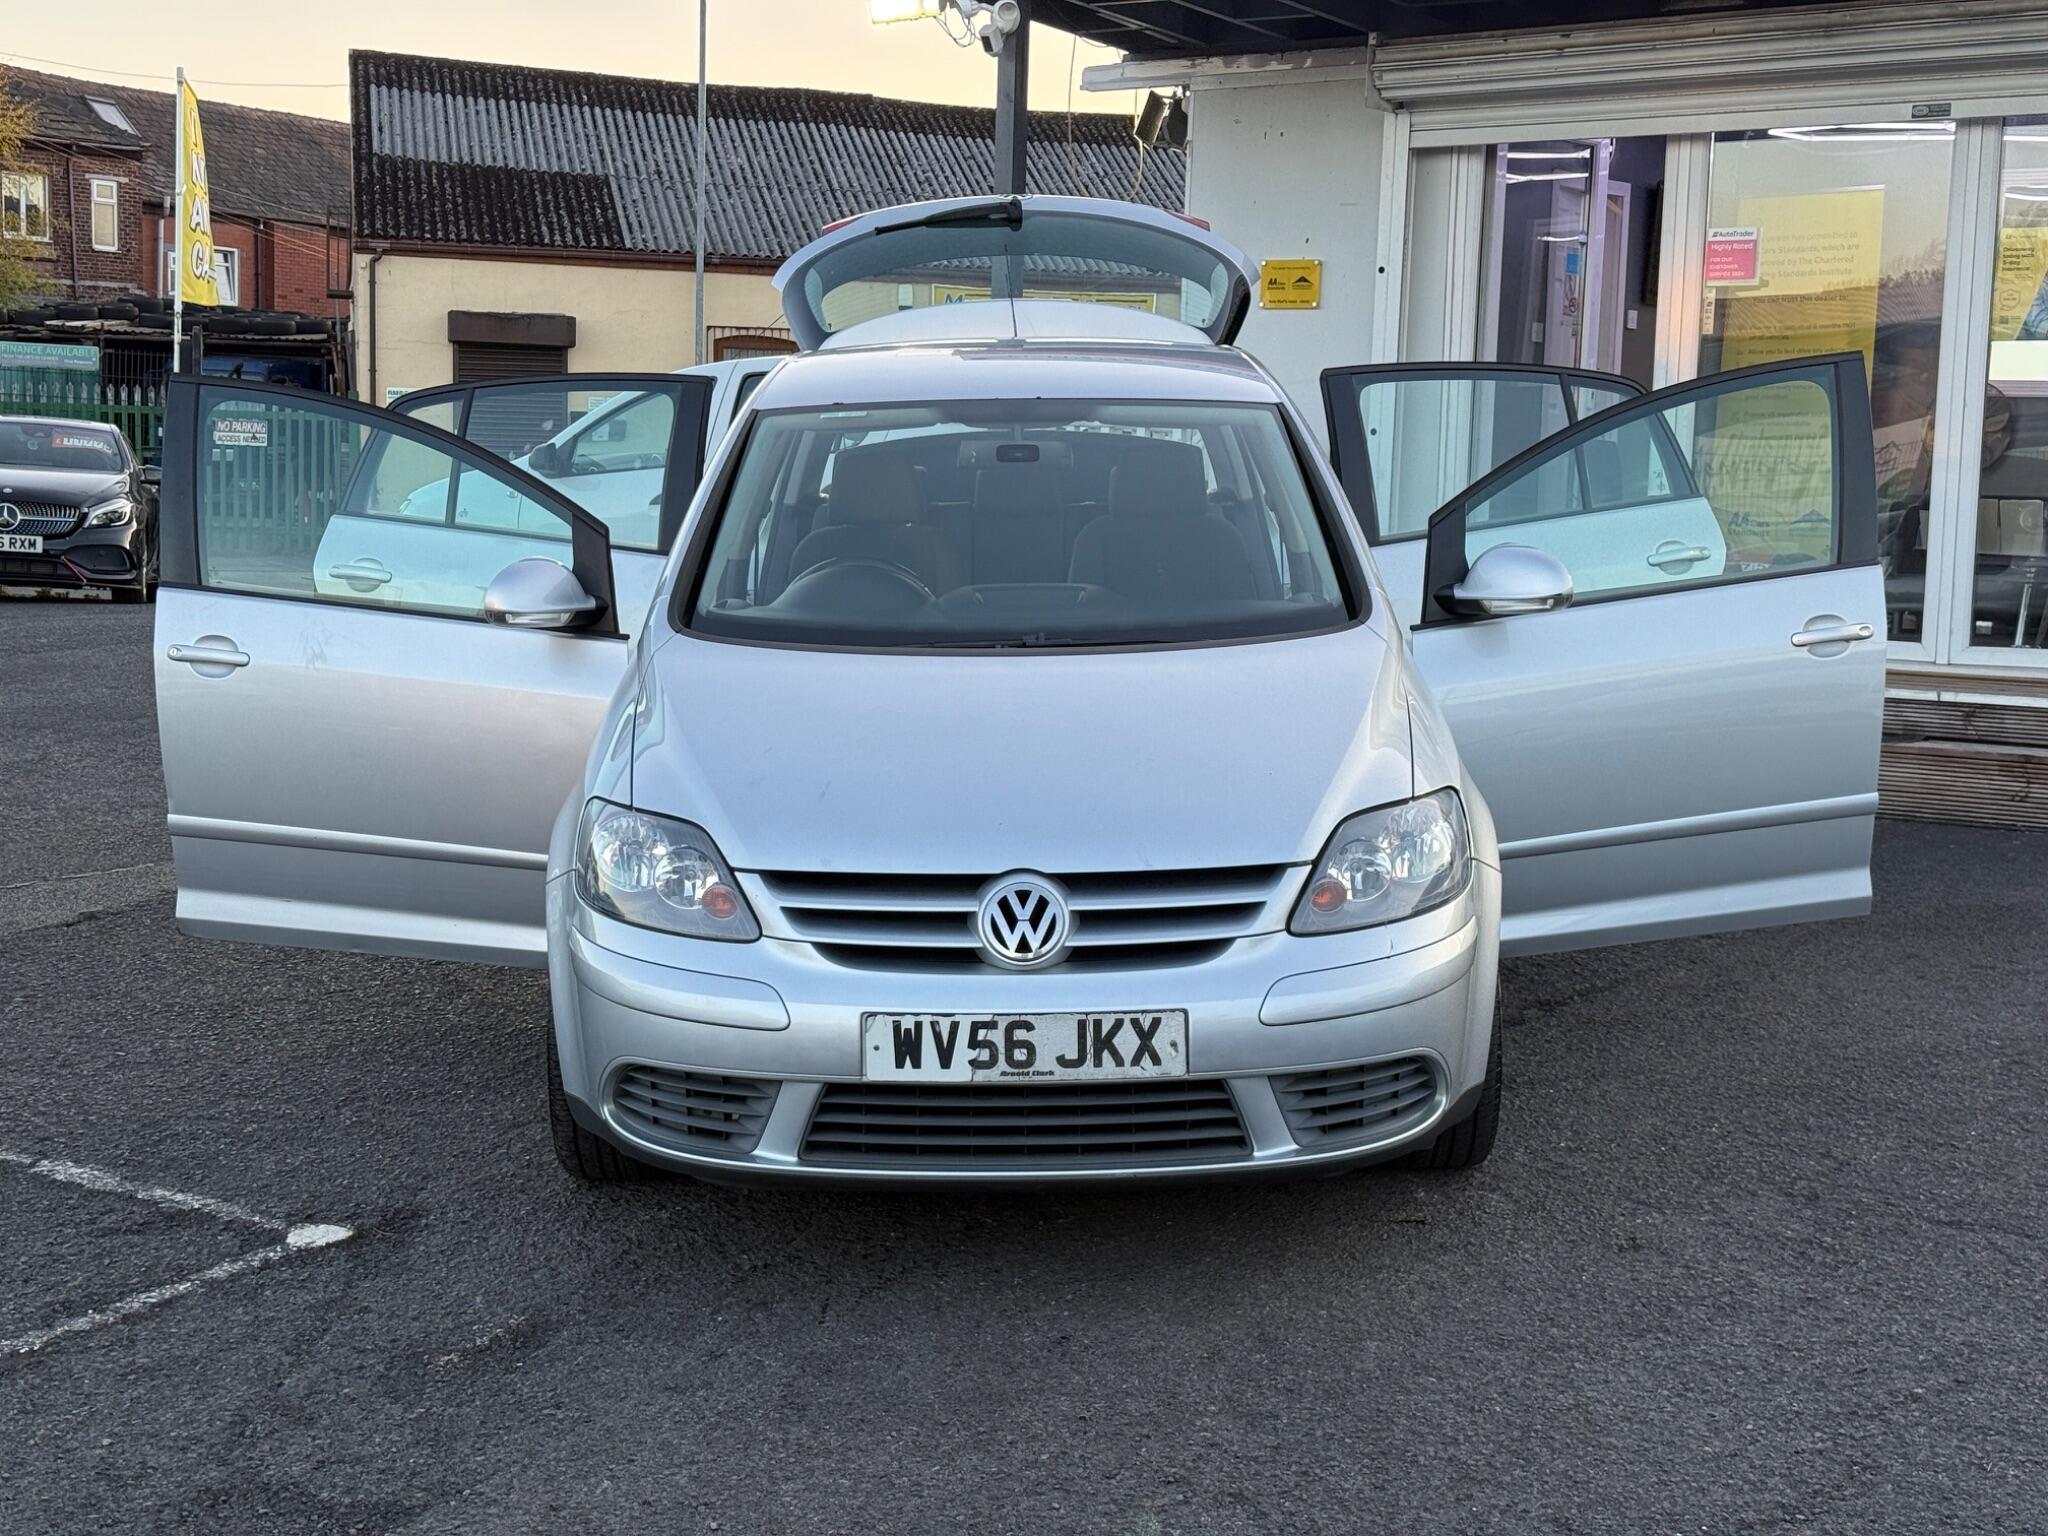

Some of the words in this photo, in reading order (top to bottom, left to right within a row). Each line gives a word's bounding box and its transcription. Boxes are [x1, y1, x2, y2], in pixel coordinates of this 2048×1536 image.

[1718, 230, 1754, 238] AutoTrader
[1, 343, 43, 355] FINANCE
[45, 346, 97, 358] AVAILABLE
[217, 420, 231, 432] NO
[231, 421, 266, 433] PARKING
[8, 536, 37, 551] RXM
[891, 1018, 1037, 1071] WV56
[1055, 1016, 1163, 1069] JKX
[999, 1070, 1031, 1078] Arnold
[1031, 1069, 1055, 1077] Clark
